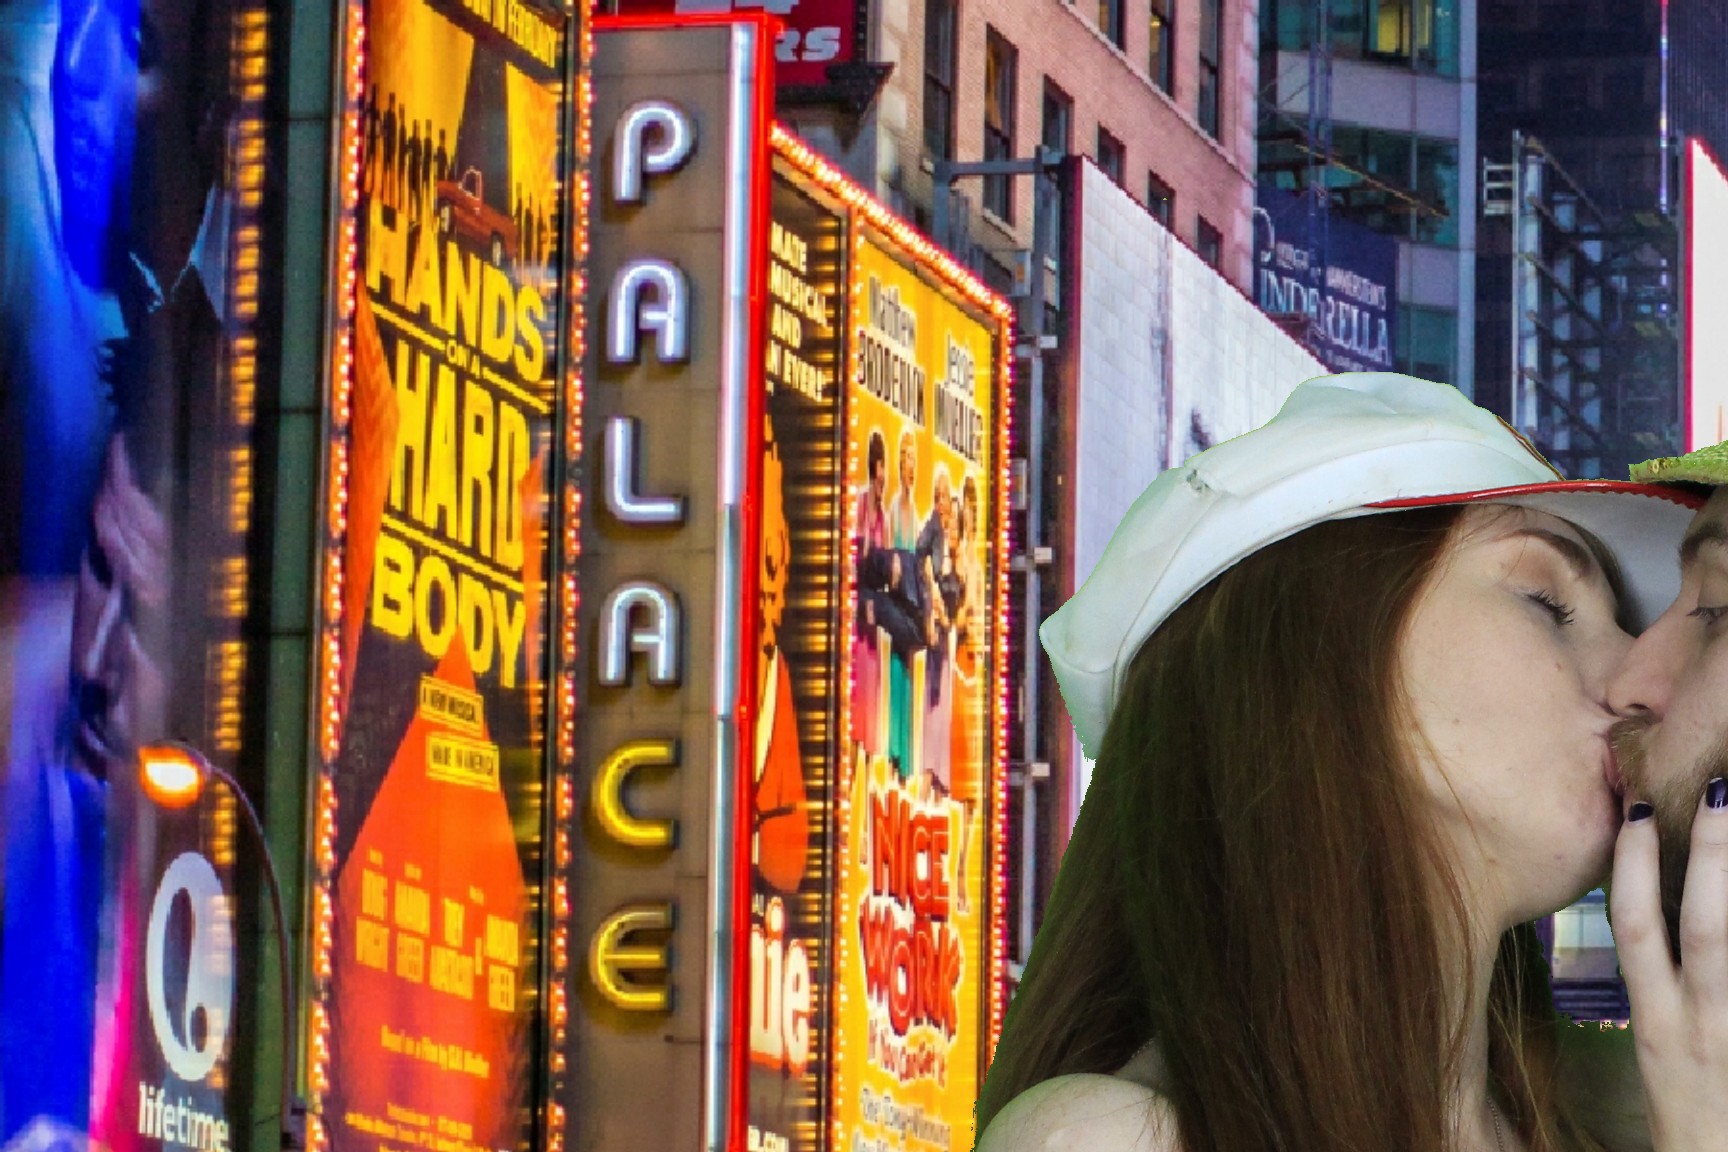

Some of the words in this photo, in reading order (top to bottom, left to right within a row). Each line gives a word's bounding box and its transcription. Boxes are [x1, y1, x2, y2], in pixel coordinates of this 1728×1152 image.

[366, 197, 546, 382] HANDS
[390, 339, 530, 571] HARD
[372, 537, 527, 688] BODY
[588, 100, 694, 1012] PALACE
[872, 789, 949, 922] NICE
[859, 898, 961, 1043] WORK
